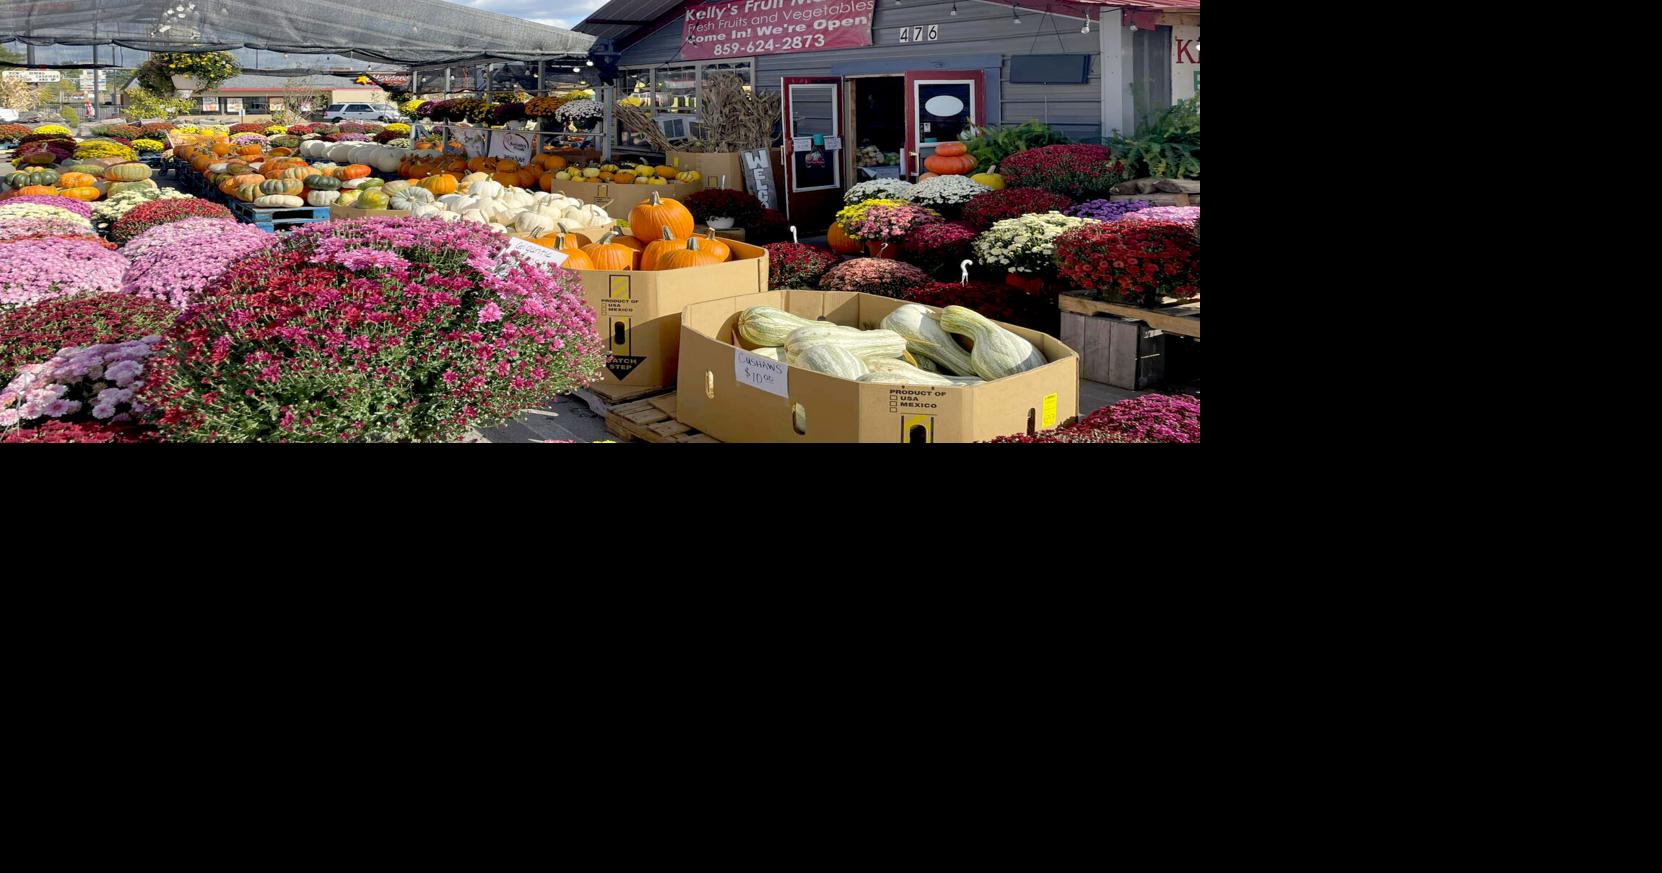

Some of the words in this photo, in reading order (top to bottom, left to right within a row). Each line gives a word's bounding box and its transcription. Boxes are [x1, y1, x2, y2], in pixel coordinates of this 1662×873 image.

[686, 4, 738, 21] Kelly's
[688, 21, 715, 33] Fresh
[718, 17, 748, 29] Fruits
[751, 12, 779, 25] and
[783, 1, 874, 21] Vegetables
[731, 29, 752, 39] In!
[757, 24, 807, 37] We're
[713, 34, 825, 56] 859-624-2873
[1175, 36, 1200, 64] K
